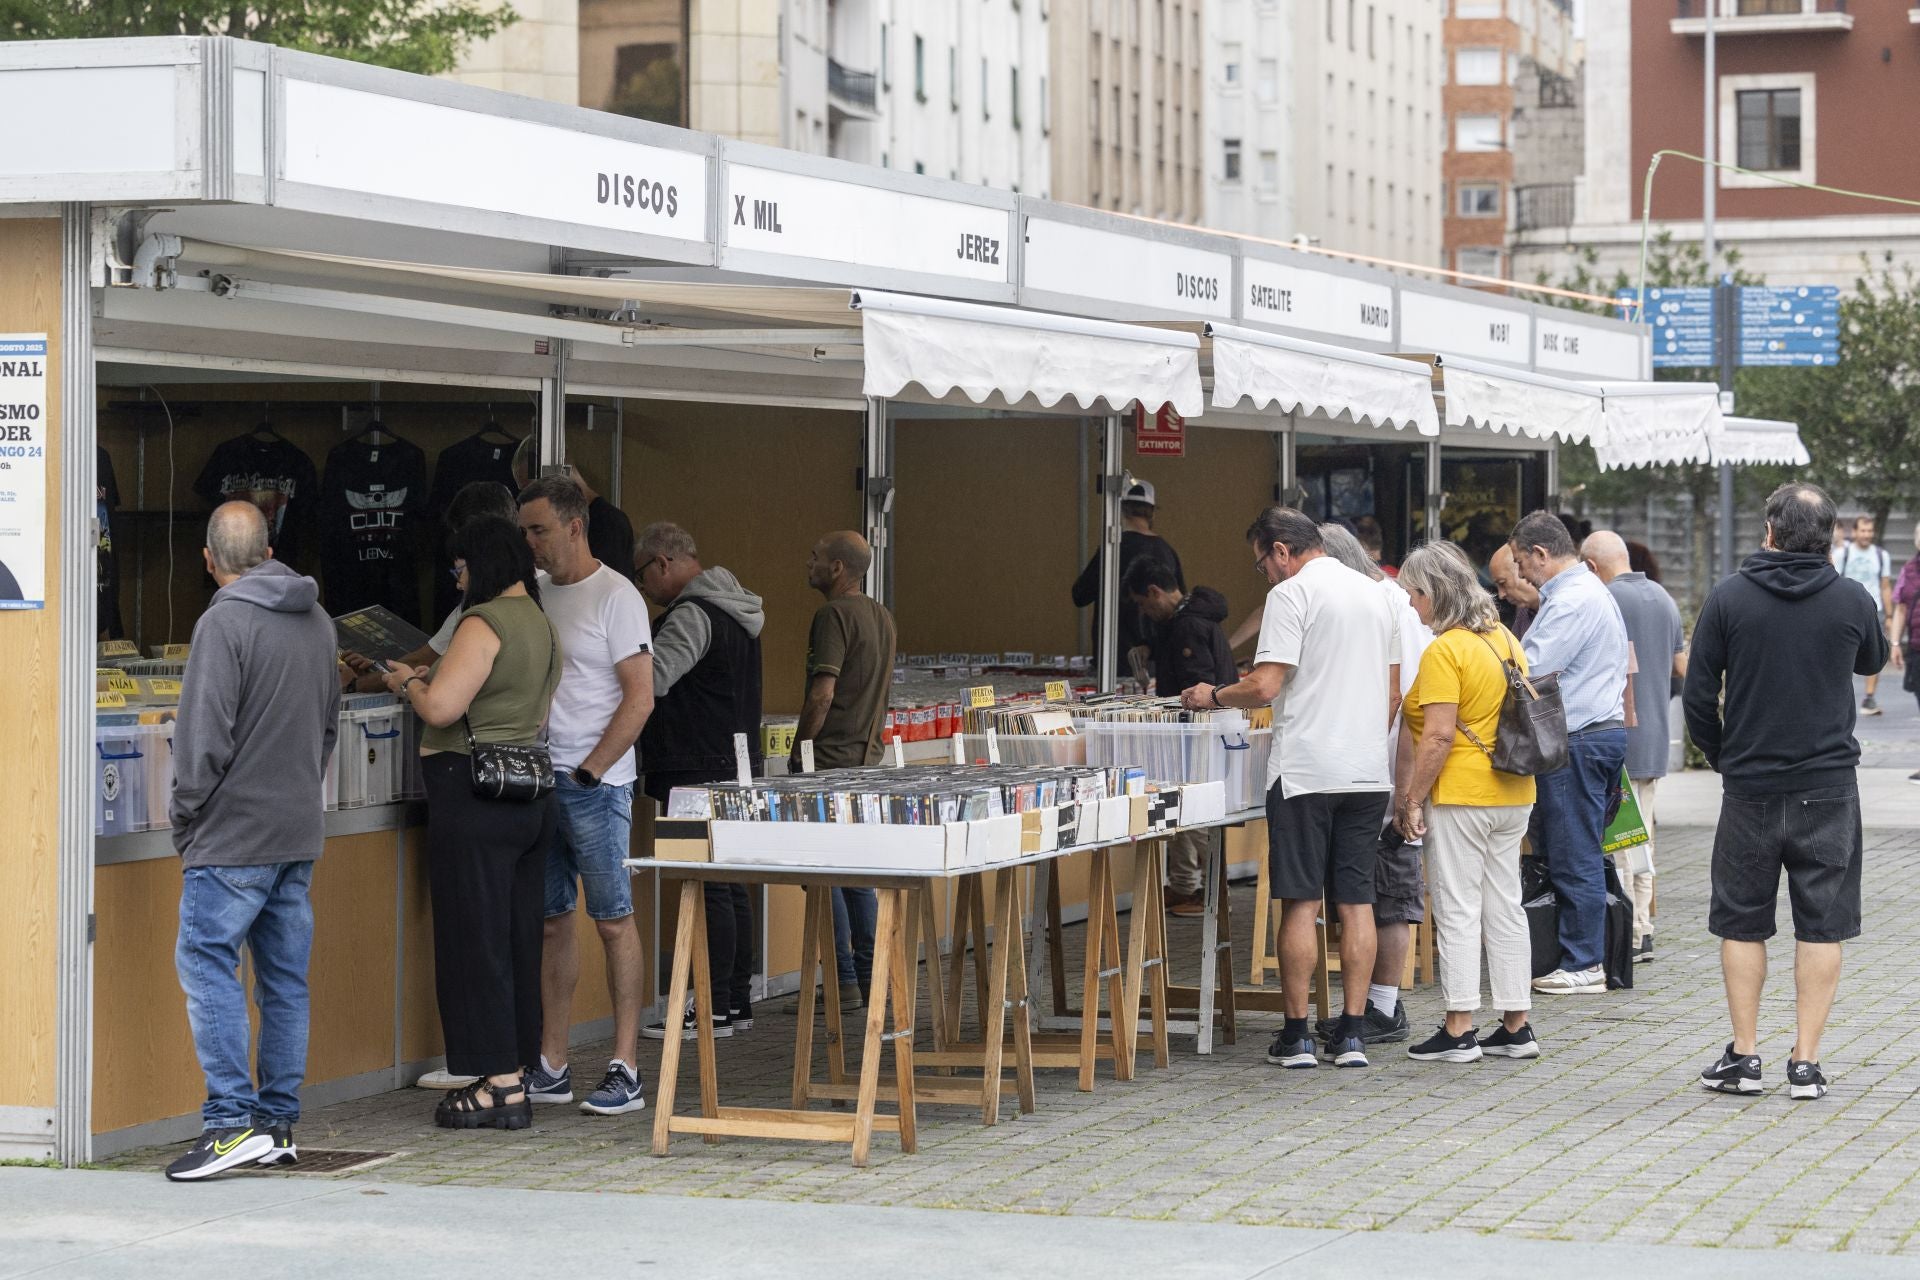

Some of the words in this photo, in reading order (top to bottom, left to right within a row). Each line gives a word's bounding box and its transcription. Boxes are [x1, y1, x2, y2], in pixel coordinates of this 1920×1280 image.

[597, 173, 678, 218] DISCOS
[734, 195, 745, 225] X
[754, 200, 782, 233] MIL
[957, 233, 999, 265] JEREZ
[1177, 272, 1218, 301] DISCOS
[1251, 284, 1291, 312] SATELITE
[1360, 303, 1389, 328] MADRID
[1564, 336, 1579, 355] CINE
[0, 362, 42, 377] NAL
[0, 404, 40, 420] SMO
[28, 446, 42, 457] 24
[1139, 440, 1181, 449] EXTINTOR
[350, 511, 404, 530] CULT
[941, 654, 968, 664] HEAVY
[972, 655, 998, 665] HEAVY
[1005, 654, 1032, 664] HEAVY
[109, 678, 133, 690] SALSA
[971, 687, 993, 697] OFERTAS
[1603, 838, 1631, 851] BRASIL
[1631, 833, 1648, 843] VIA
